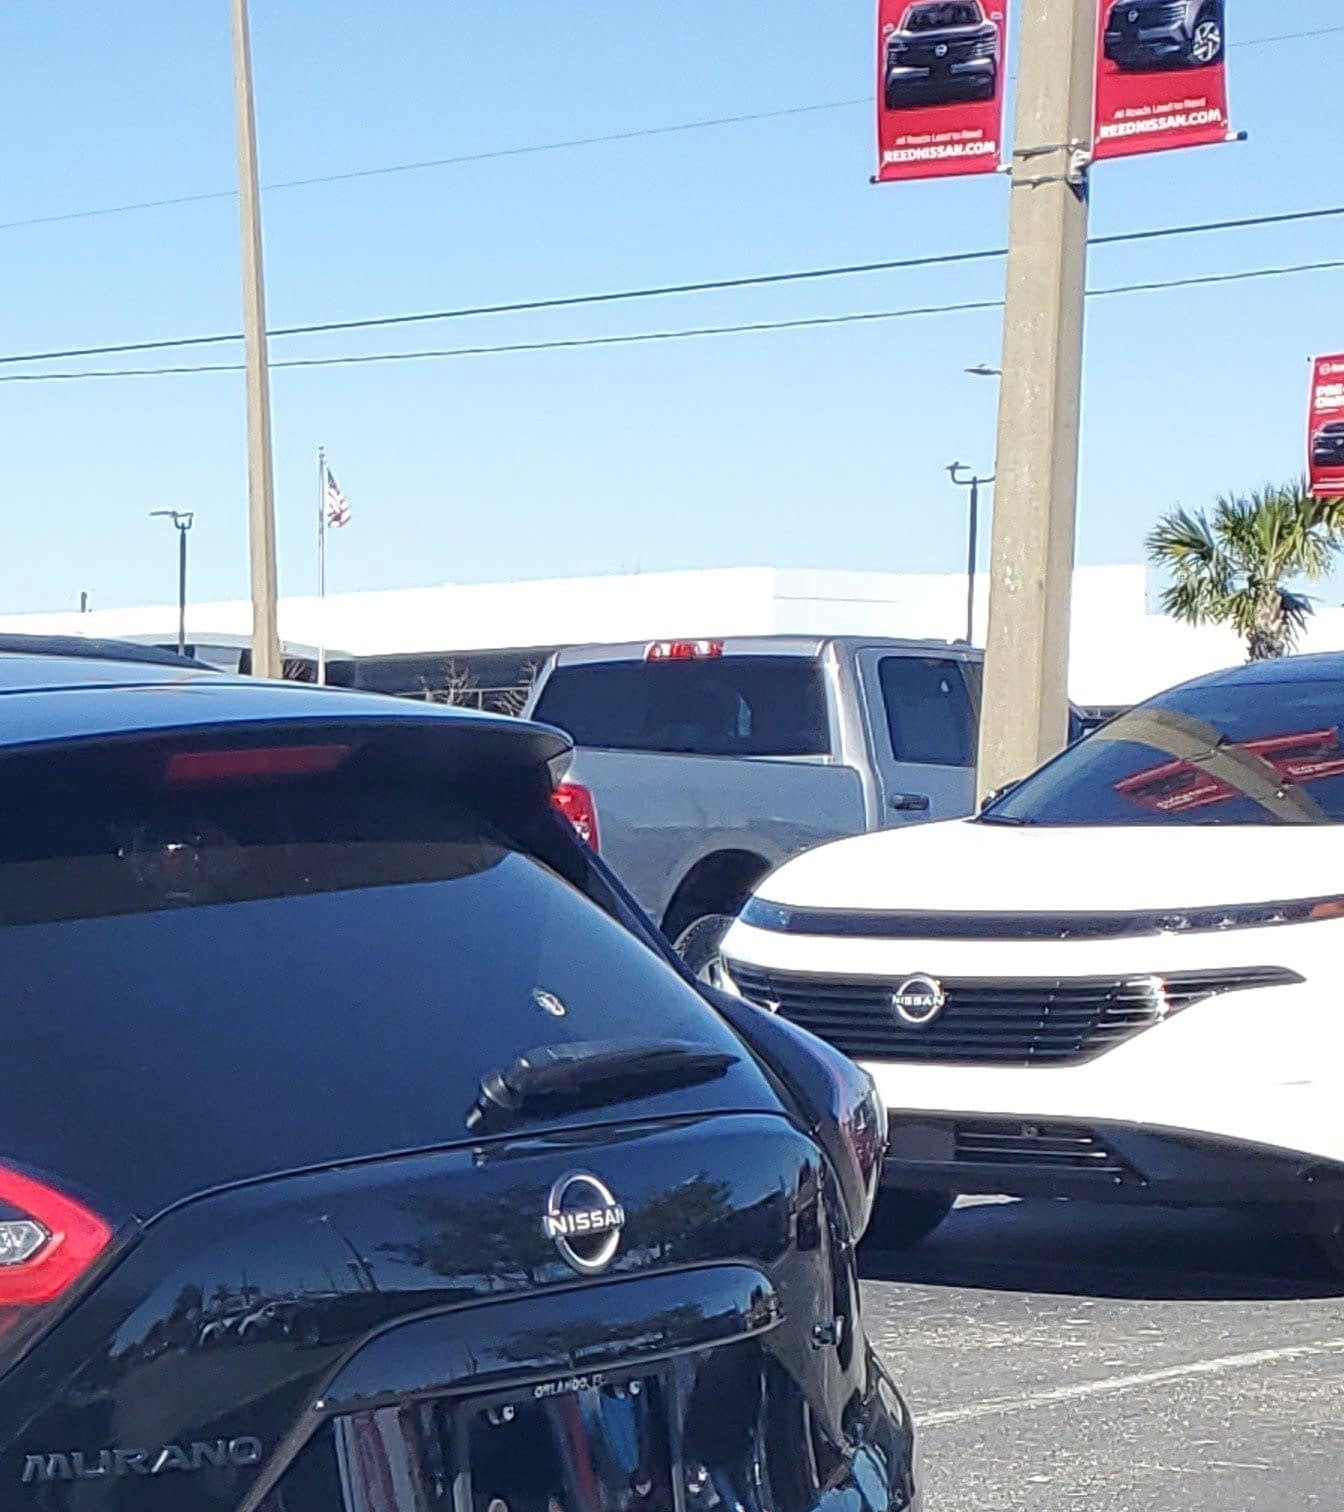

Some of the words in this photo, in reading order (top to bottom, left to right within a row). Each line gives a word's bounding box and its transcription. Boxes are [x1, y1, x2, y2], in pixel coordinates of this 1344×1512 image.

[1100, 108, 1221, 138] REEDNISSAN.COM
[883, 141, 996, 163] REEDNISSAN.COM
[892, 994, 945, 1006] NISSAN
[548, 1207, 625, 1236] NISSAN
[22, 1436, 262, 1482] MURANO
